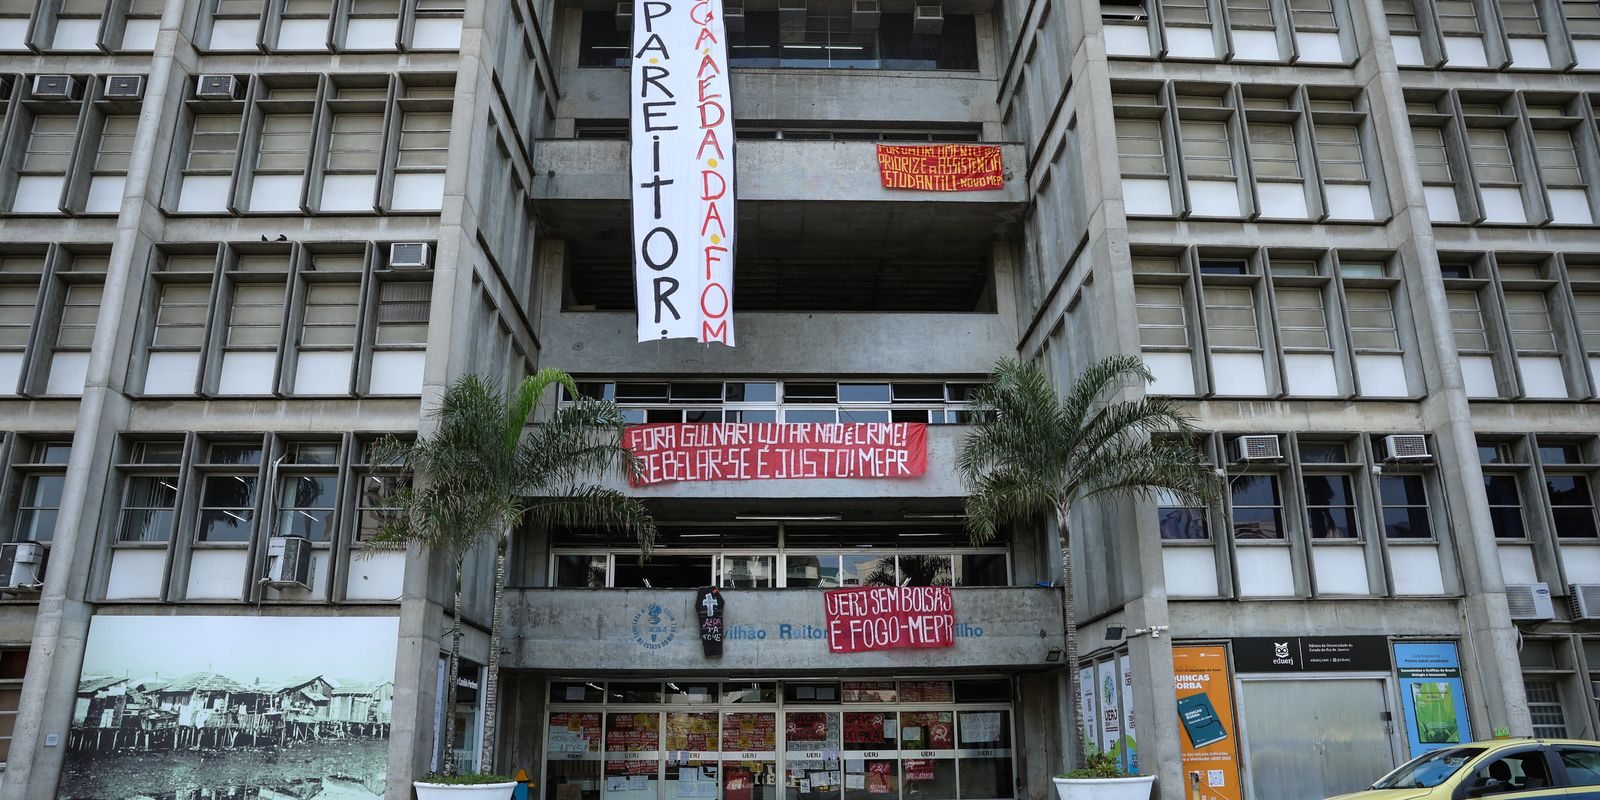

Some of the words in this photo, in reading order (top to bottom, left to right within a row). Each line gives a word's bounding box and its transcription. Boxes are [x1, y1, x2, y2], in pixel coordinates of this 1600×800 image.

[878, 153, 927, 174] PRIORIZE
[631, 425, 676, 451] FORA
[680, 422, 753, 447] GULNAR!
[757, 422, 811, 444] LUTAR
[855, 422, 908, 447] CRIME!
[634, 447, 751, 483] REBELAR-SE
[757, 444, 771, 478] É
[775, 448, 855, 478] JUSTO!
[858, 447, 911, 477] MEPR
[826, 590, 868, 617] UERJ
[870, 587, 899, 614] SEM
[830, 614, 843, 650] É
[955, 622, 984, 638] ilho
[1272, 657, 1294, 666] eduerj
